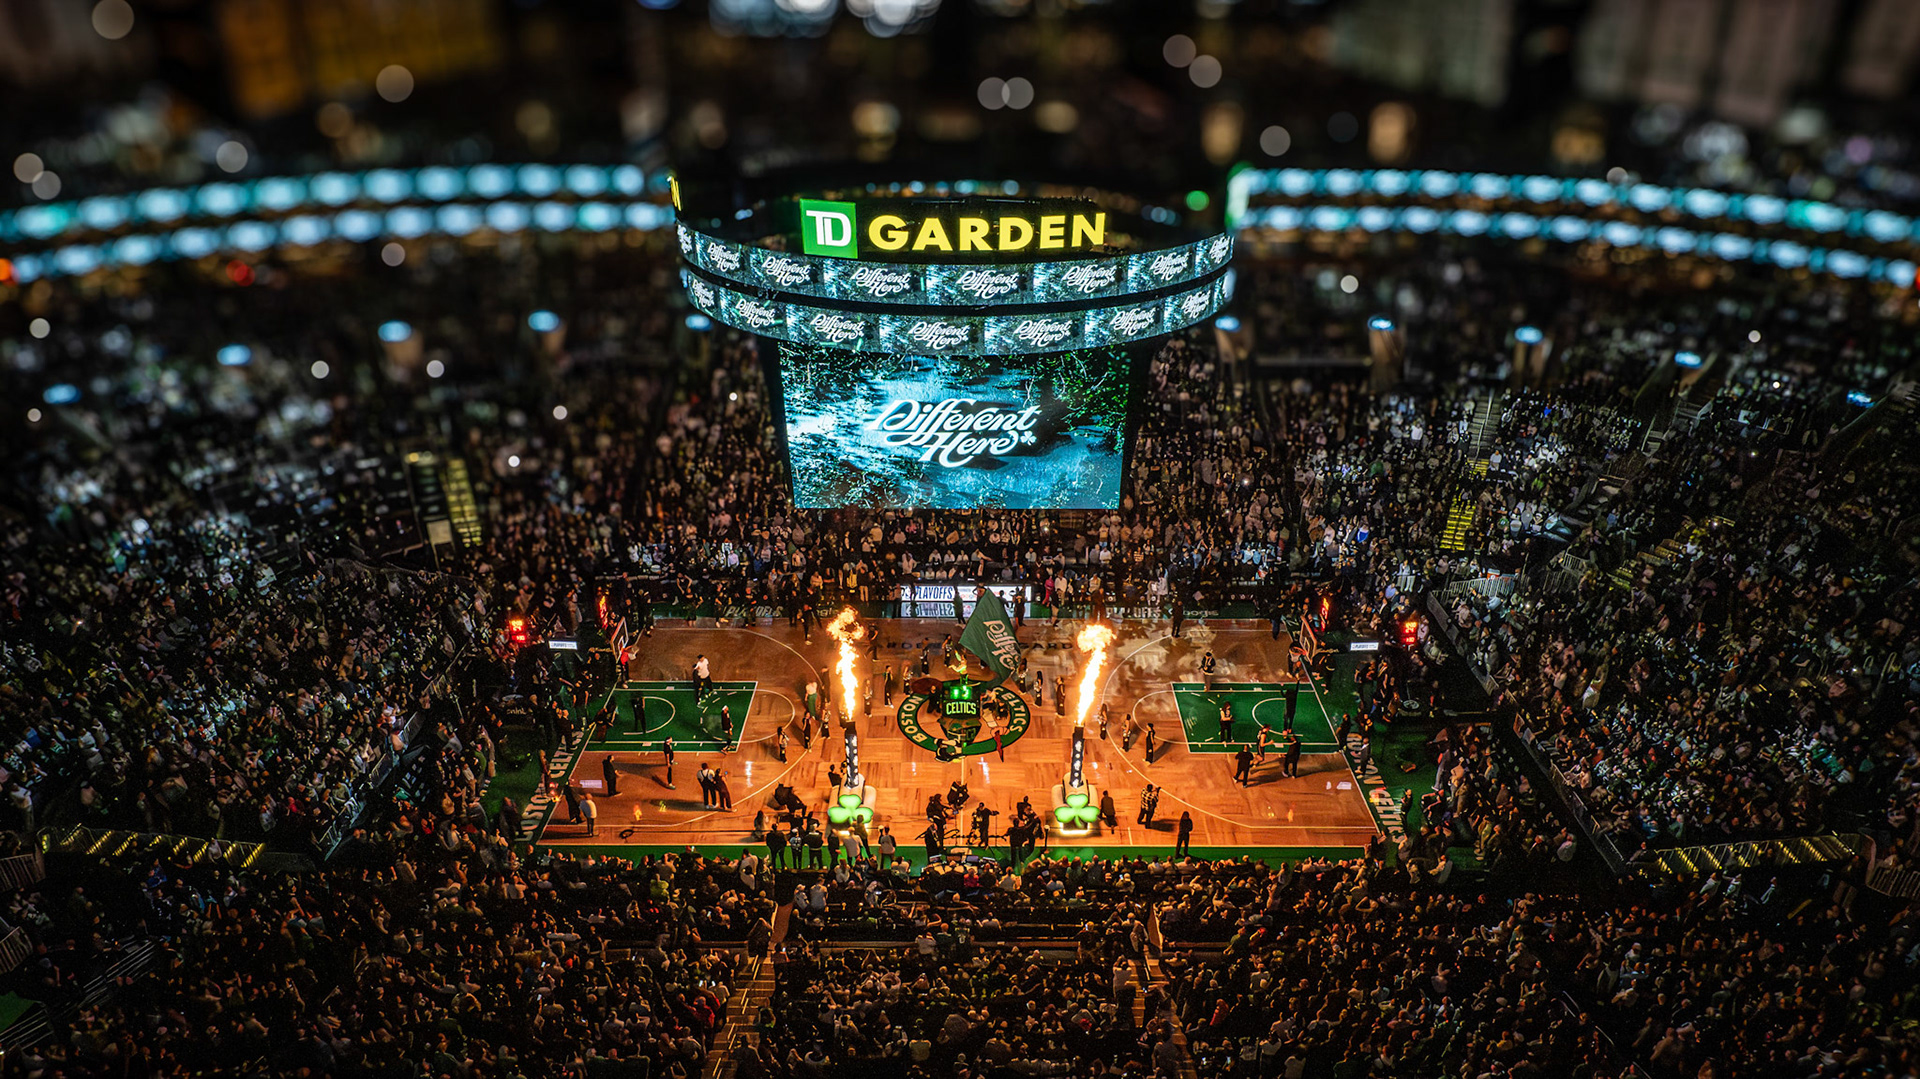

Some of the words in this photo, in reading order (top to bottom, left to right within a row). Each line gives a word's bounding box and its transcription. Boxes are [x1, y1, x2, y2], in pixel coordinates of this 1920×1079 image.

[805, 210, 852, 247] TD
[868, 213, 1106, 250] GARDEN
[762, 256, 810, 277] Different
[1062, 265, 1116, 286] Different
[851, 267, 911, 288] Different
[956, 270, 1018, 289] Different
[810, 313, 864, 335] Different
[908, 322, 969, 343] Different
[1013, 319, 1071, 340] Different
[866, 398, 1041, 441] Different
[918, 429, 1019, 468] Here
[946, 701, 976, 715] CELTICS
[901, 696, 928, 743] BOSTON
